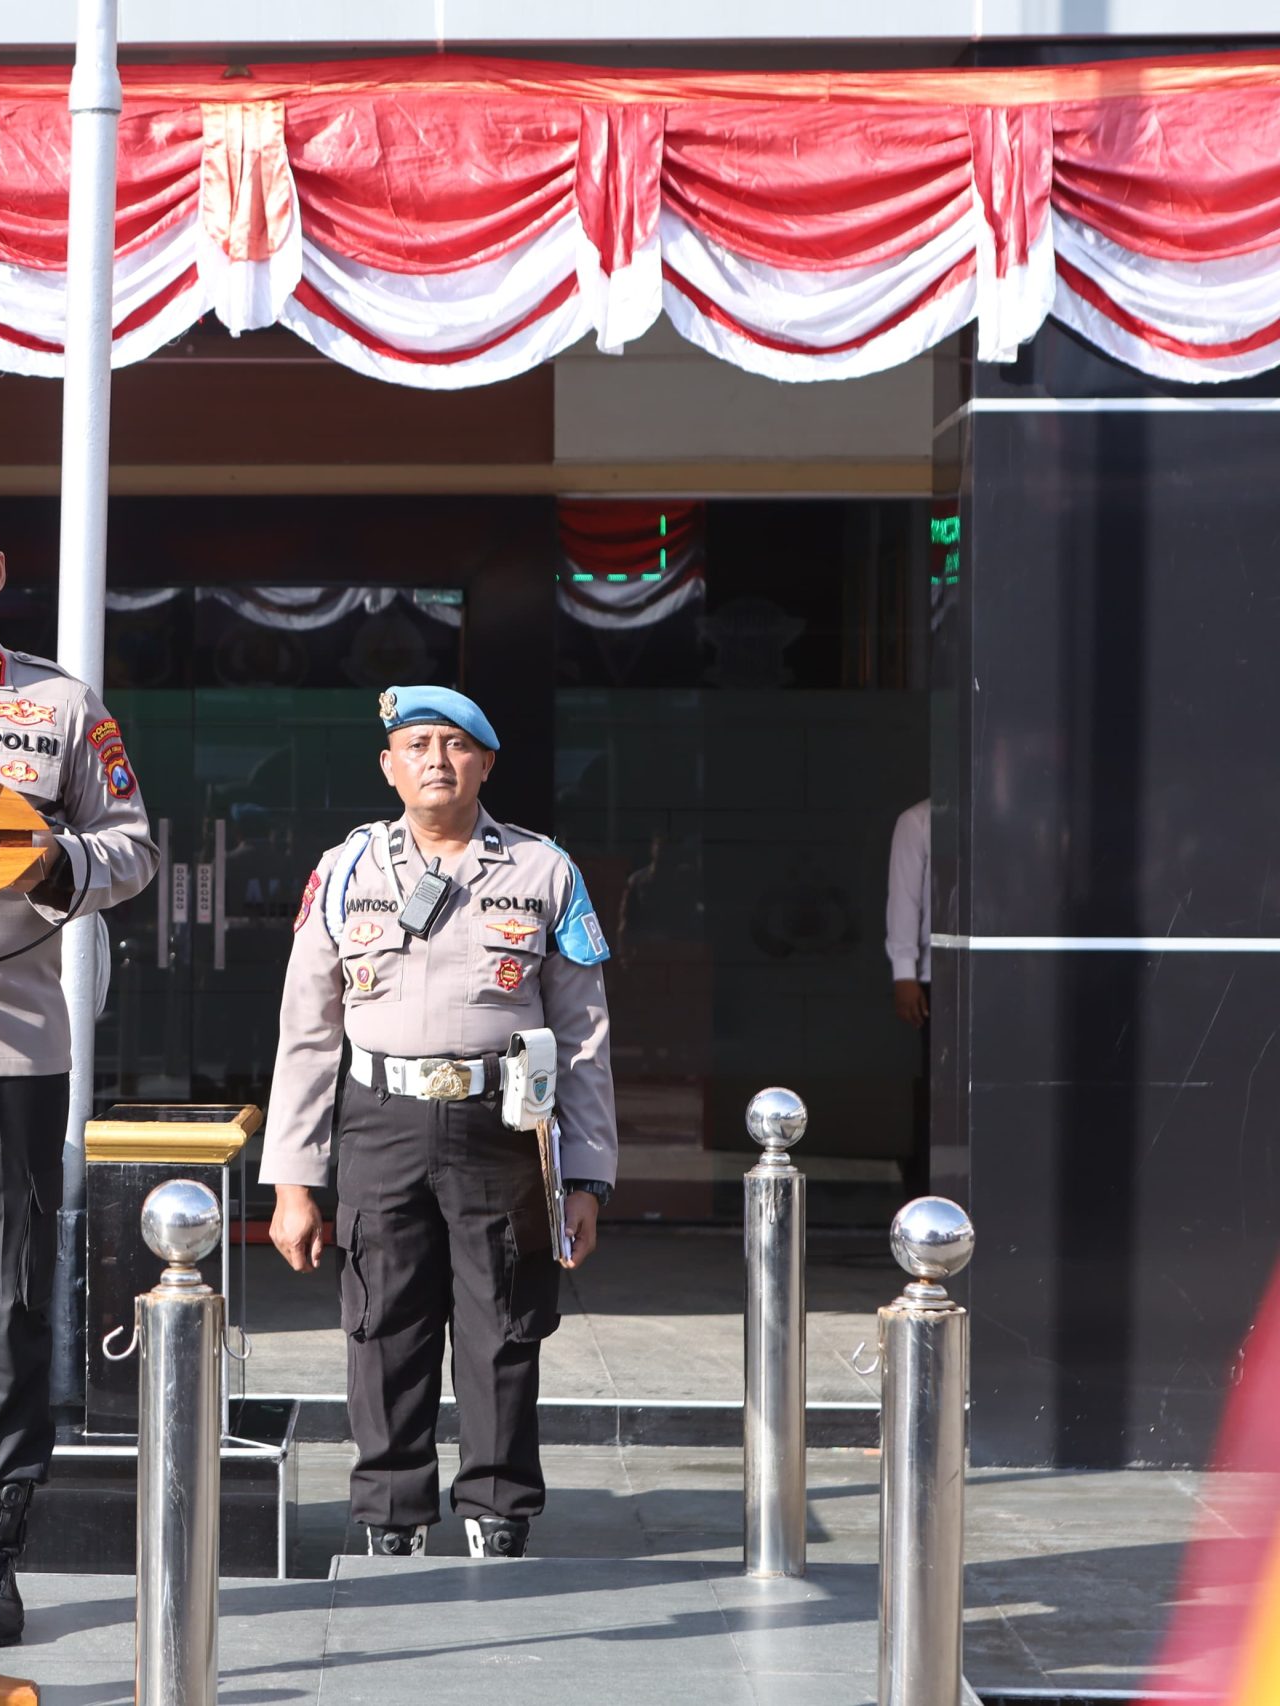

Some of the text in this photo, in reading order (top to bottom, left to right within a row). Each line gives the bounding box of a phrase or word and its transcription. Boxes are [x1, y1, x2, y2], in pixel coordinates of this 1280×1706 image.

[176, 867, 185, 910] DORONG
[200, 868, 209, 911] DORONG
[480, 896, 543, 913] POLRI
